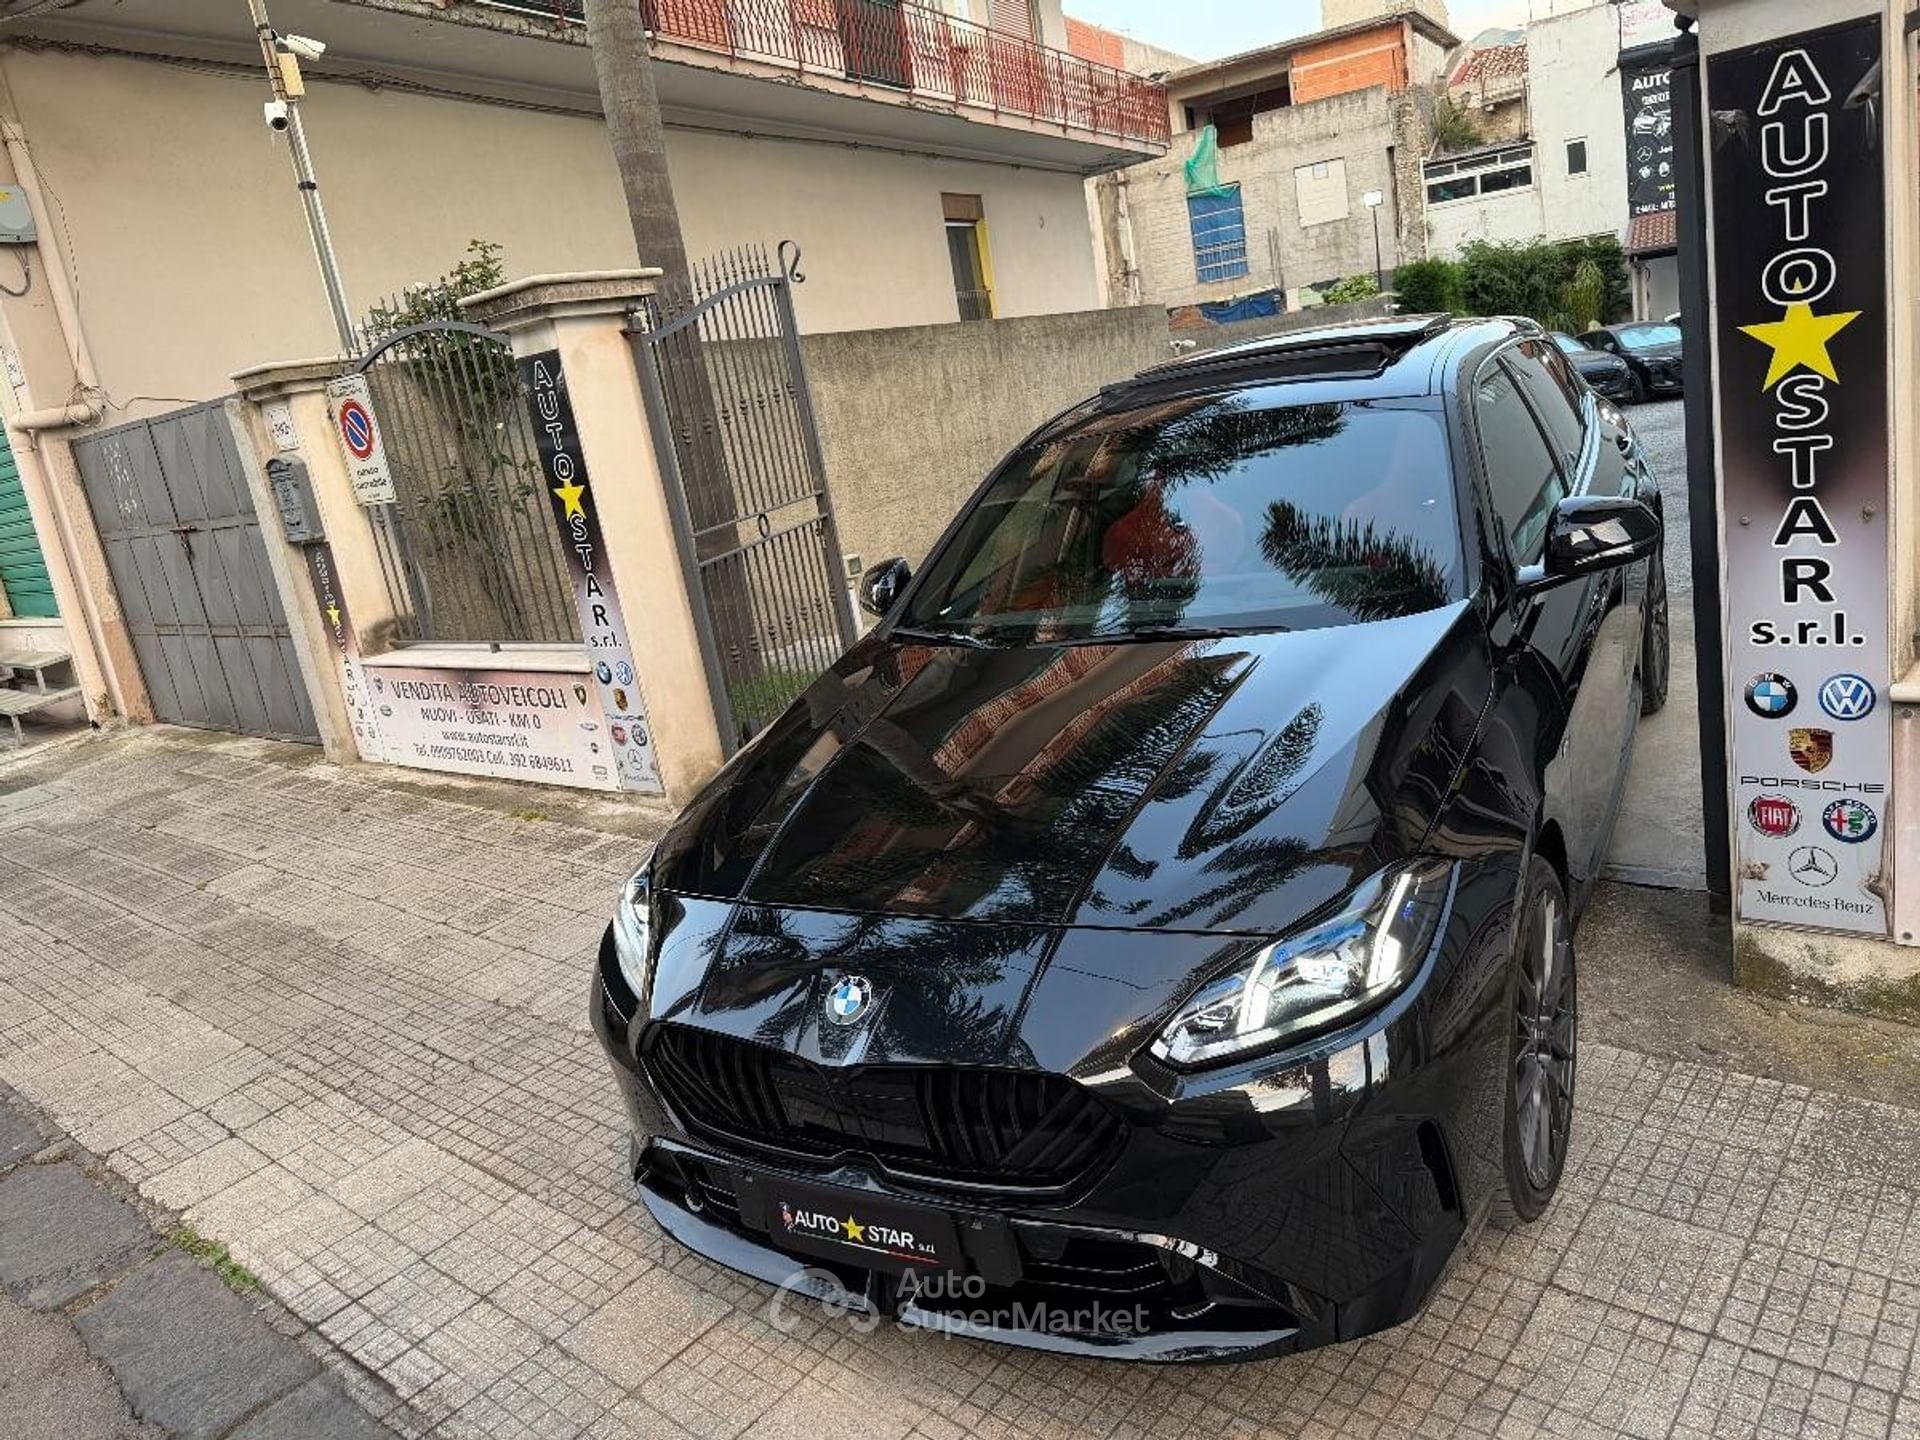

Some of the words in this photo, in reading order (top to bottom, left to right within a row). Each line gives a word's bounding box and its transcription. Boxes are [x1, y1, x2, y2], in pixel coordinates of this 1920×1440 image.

[1757, 48, 1837, 306] AUTO
[534, 360, 575, 481] AUTO
[569, 513, 609, 627] STAR
[1772, 374, 1840, 605] STAR
[590, 631, 623, 648] s.r.l.
[1750, 612, 1866, 646] s.r.l.
[390, 680, 456, 702] VENDITA
[420, 706, 458, 723] NUOVI
[466, 710, 500, 726] USATI
[509, 752, 527, 768] 392
[1740, 776, 1885, 793] PORSCHE
[1760, 806, 1790, 827] FIAT
[1756, 889, 1875, 916] Mercedes-Benz
[794, 1210, 840, 1233] AUTO
[868, 1225, 915, 1249] STAR
